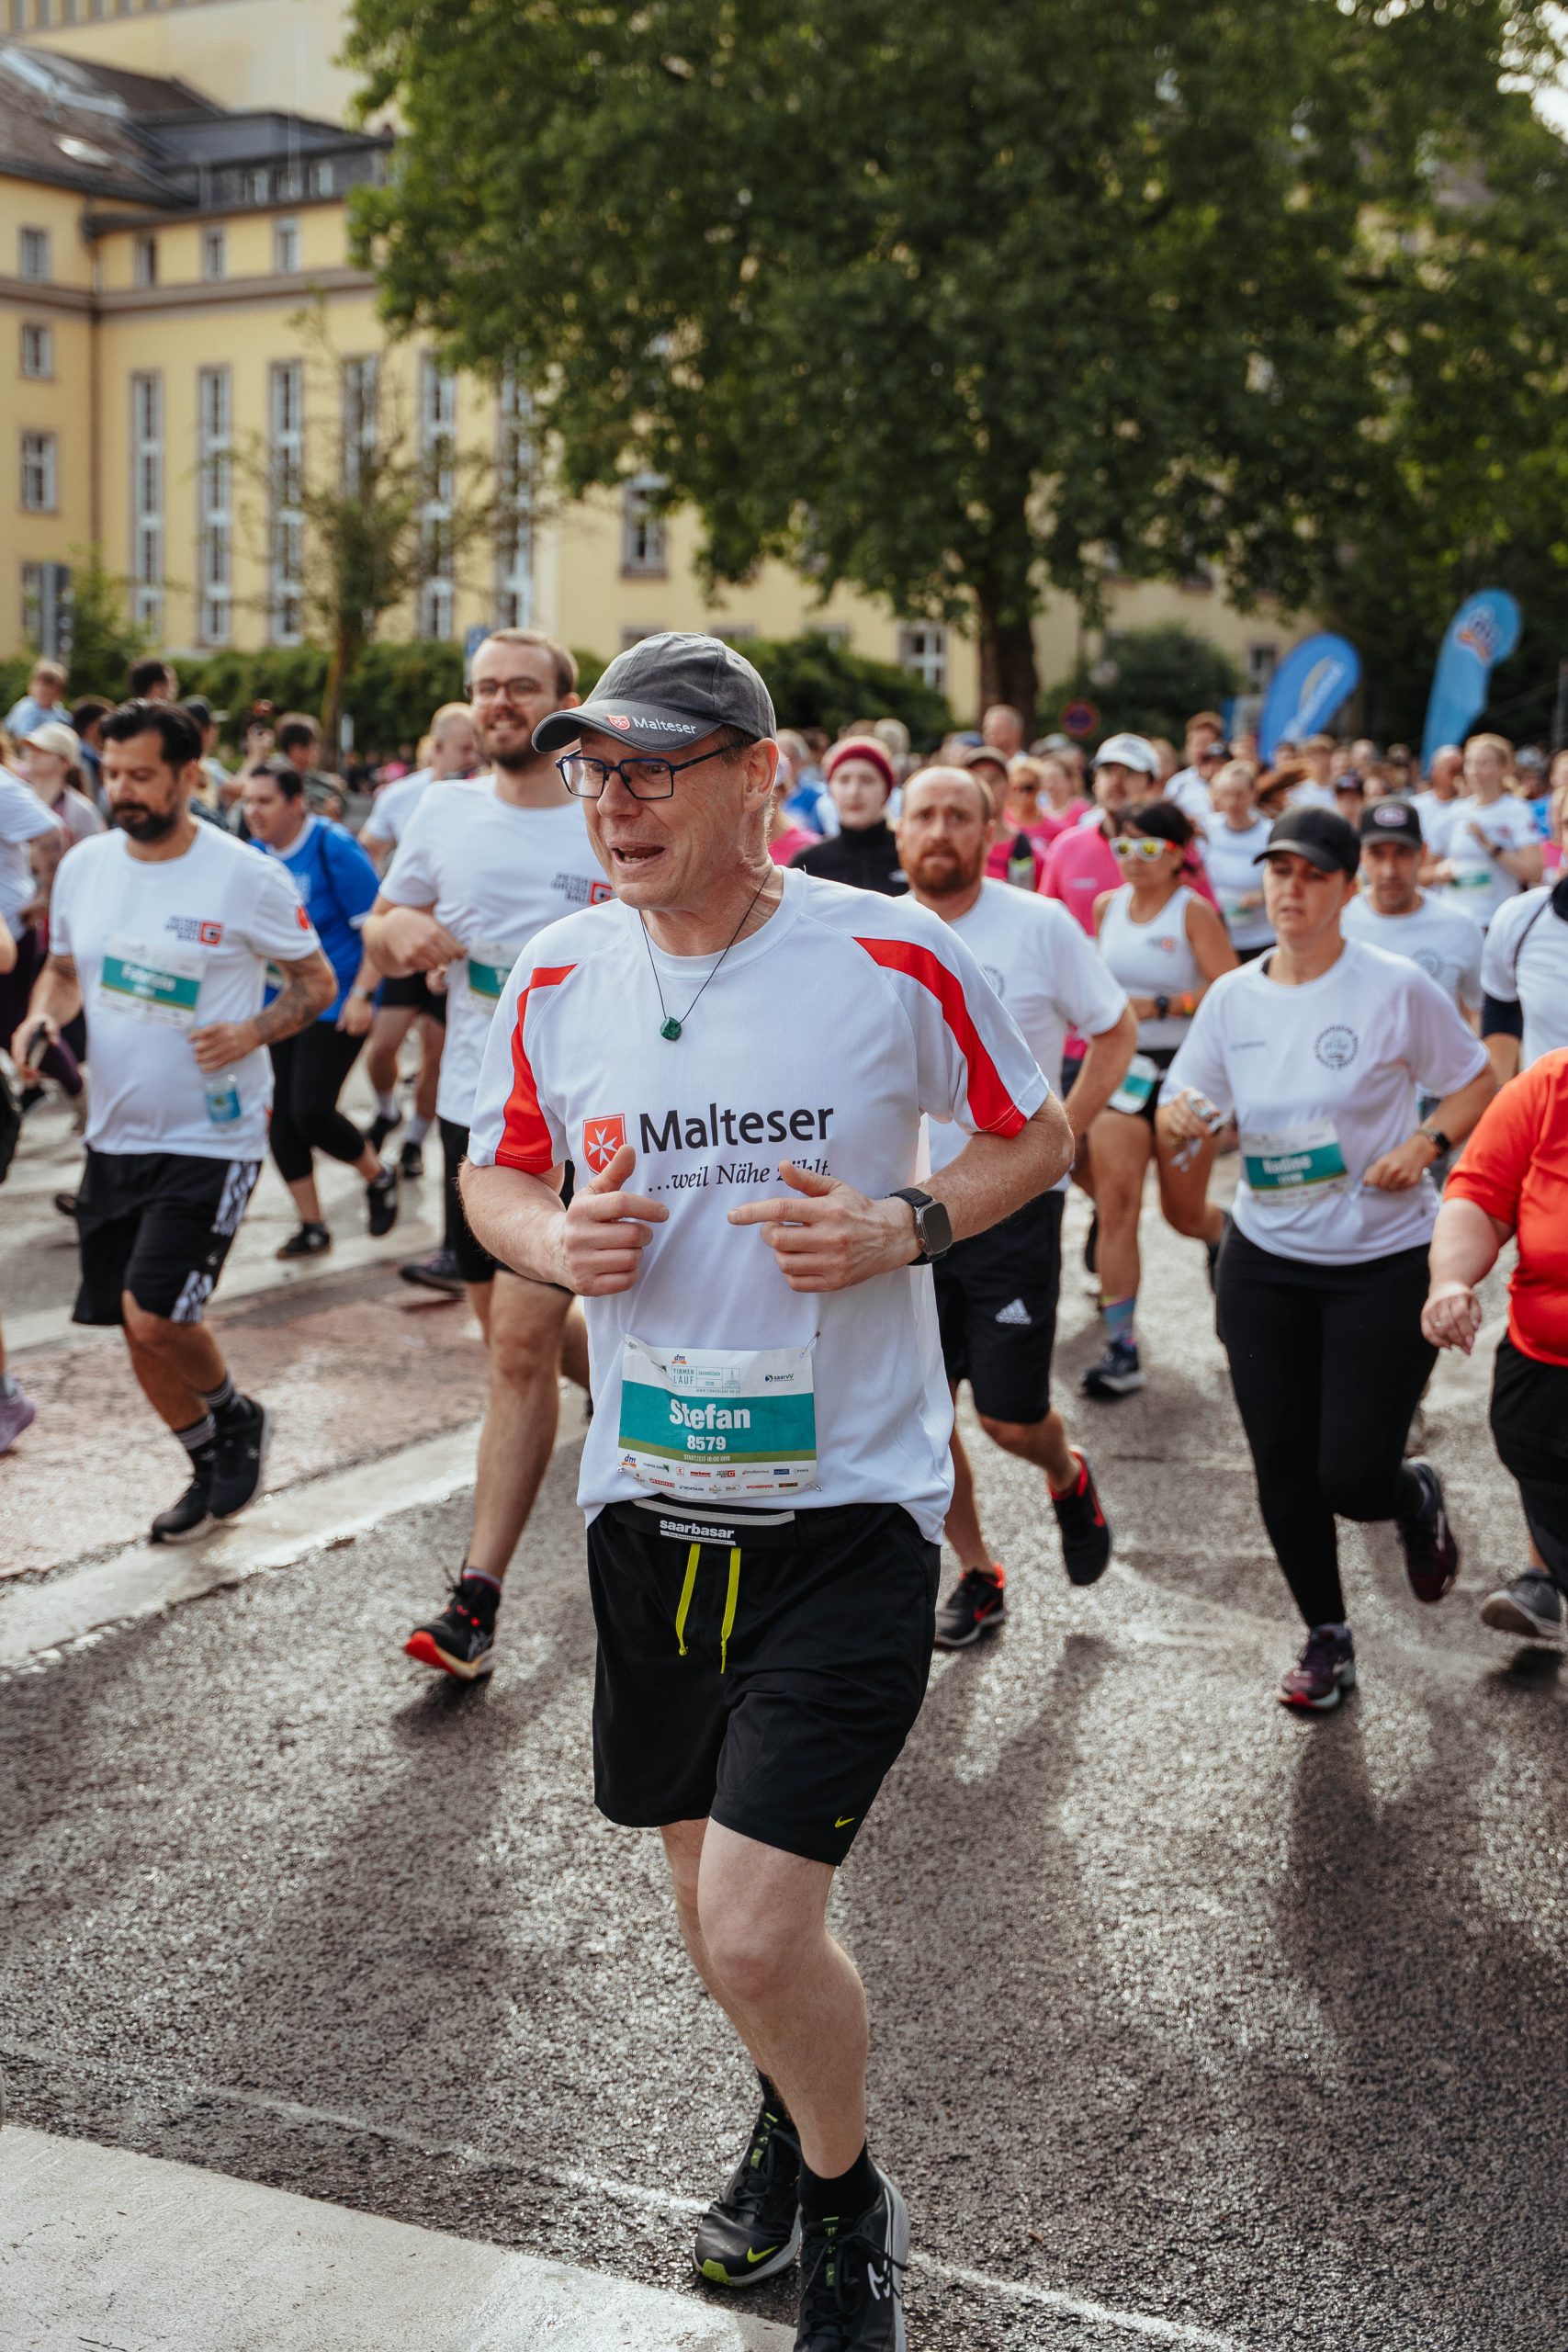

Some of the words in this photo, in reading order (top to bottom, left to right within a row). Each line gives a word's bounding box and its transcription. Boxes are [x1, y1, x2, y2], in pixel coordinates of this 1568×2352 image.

[632, 717, 696, 733] Malteser
[639, 1102, 834, 1154] Malteser
[716, 1162, 770, 1185] Nähe
[673, 1367, 694, 1375] FIRMEN
[673, 1376, 694, 1385] LAUF
[670, 1398, 750, 1430] Stefan
[687, 1434, 727, 1451] 8579
[625, 1454, 636, 1464] dm
[660, 1520, 735, 1539] saarbasar
